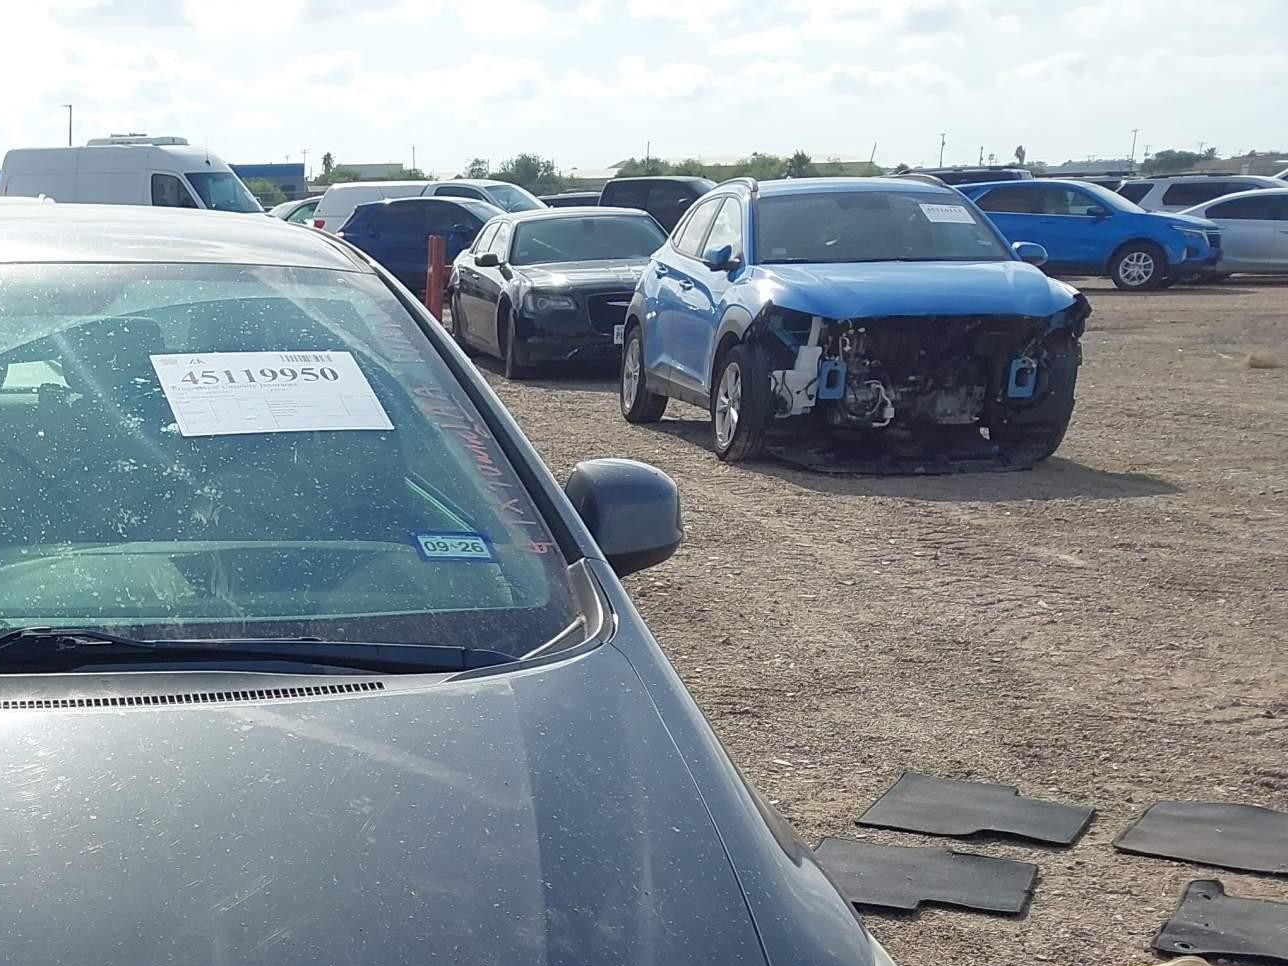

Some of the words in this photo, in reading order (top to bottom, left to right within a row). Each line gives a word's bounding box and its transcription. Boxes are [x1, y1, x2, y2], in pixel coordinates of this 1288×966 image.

[181, 366, 341, 385] 45119950
[423, 540, 450, 552] 09
[457, 541, 485, 553] 26
